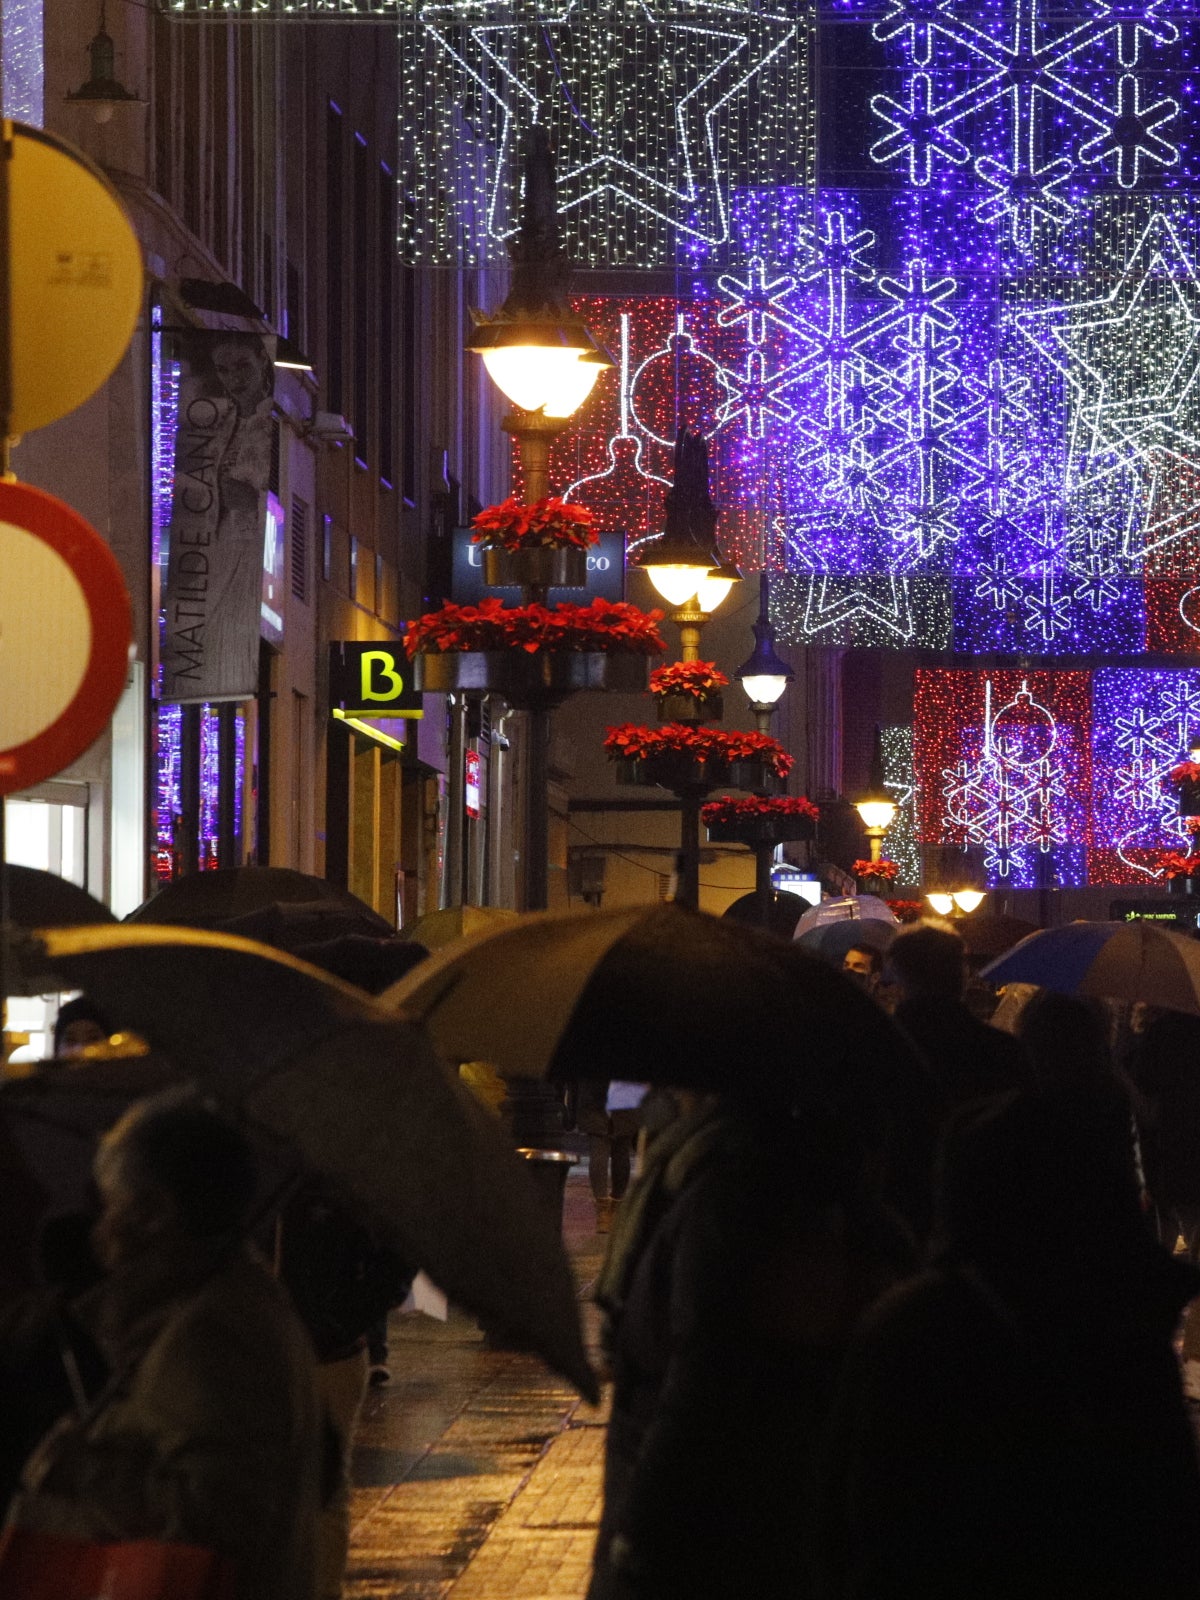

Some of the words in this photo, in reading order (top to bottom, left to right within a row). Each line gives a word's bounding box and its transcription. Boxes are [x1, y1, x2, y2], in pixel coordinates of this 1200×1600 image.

[181, 397, 219, 515] CANO
[172, 530, 212, 682] MATILDE
[361, 650, 404, 702] B
